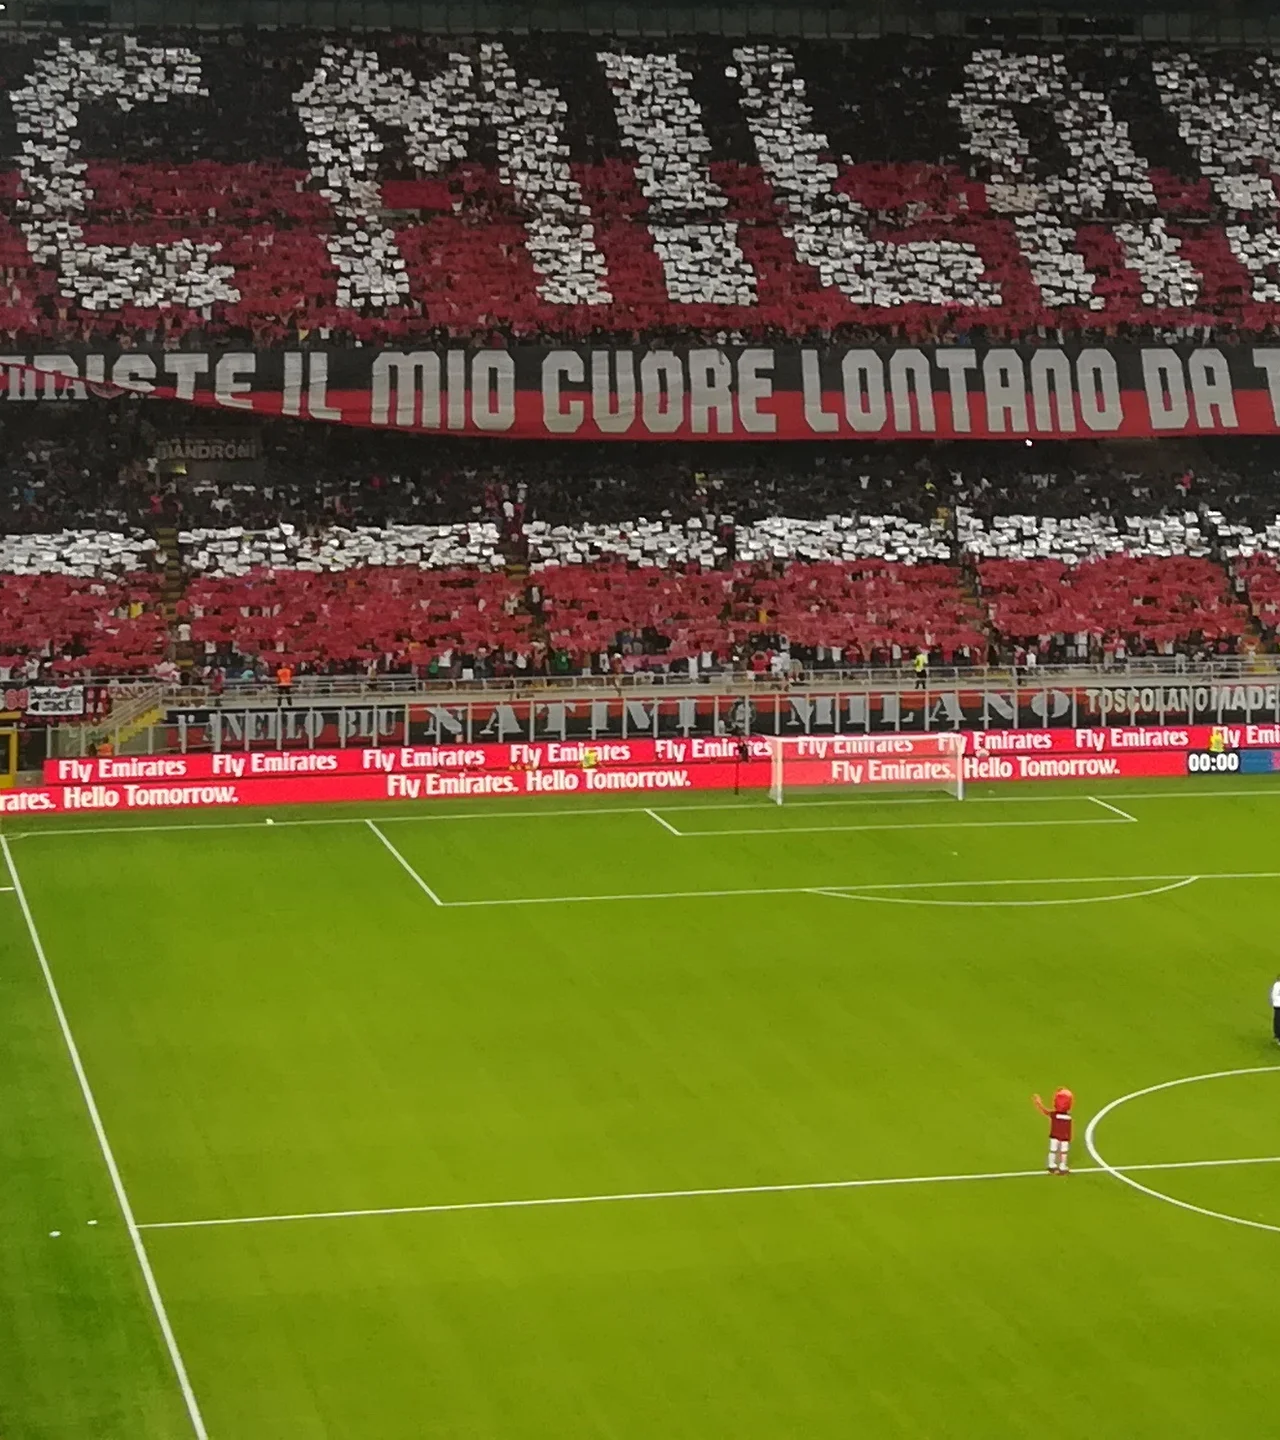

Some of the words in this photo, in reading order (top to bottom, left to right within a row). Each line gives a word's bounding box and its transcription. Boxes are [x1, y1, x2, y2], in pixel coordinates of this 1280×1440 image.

[282, 351, 342, 420] IL
[371, 349, 515, 430] MIO
[541, 349, 777, 433] CUORE
[801, 348, 1124, 433] LONTANO
[1141, 348, 1239, 429] DA
[786, 689, 1071, 726] MILANO
[1086, 687, 1208, 713] TOSCOLANO
[339, 710, 397, 738] BLU
[655, 739, 686, 763] Fly
[691, 737, 773, 759] Emirtes
[797, 736, 827, 759] Fly
[834, 736, 913, 756] Emirates
[937, 733, 966, 756] Fly
[972, 730, 1052, 750] Emirates
[1075, 728, 1105, 752] Fly
[1110, 727, 1189, 748] Emirates
[212, 753, 246, 777] Fly
[250, 752, 337, 774] Emirates
[362, 748, 395, 772] Fly
[400, 747, 485, 768] Emirates
[509, 743, 541, 769] Fly
[547, 742, 631, 763] Emiates
[1188, 752, 1238, 772] 00:00
[59, 759, 93, 783] Fly
[98, 757, 187, 779] Emirates
[831, 760, 863, 783] Fly
[868, 758, 956, 781] Emirates.
[963, 756, 1013, 779] Hello
[1016, 755, 1120, 778] Tomorrow.
[63, 785, 119, 808] Hello
[123, 784, 238, 807] Tomorrow.
[387, 773, 420, 798] Fly
[425, 772, 519, 796] Emirates.
[526, 769, 579, 792] Hello
[582, 768, 691, 790] Tomorrow.
